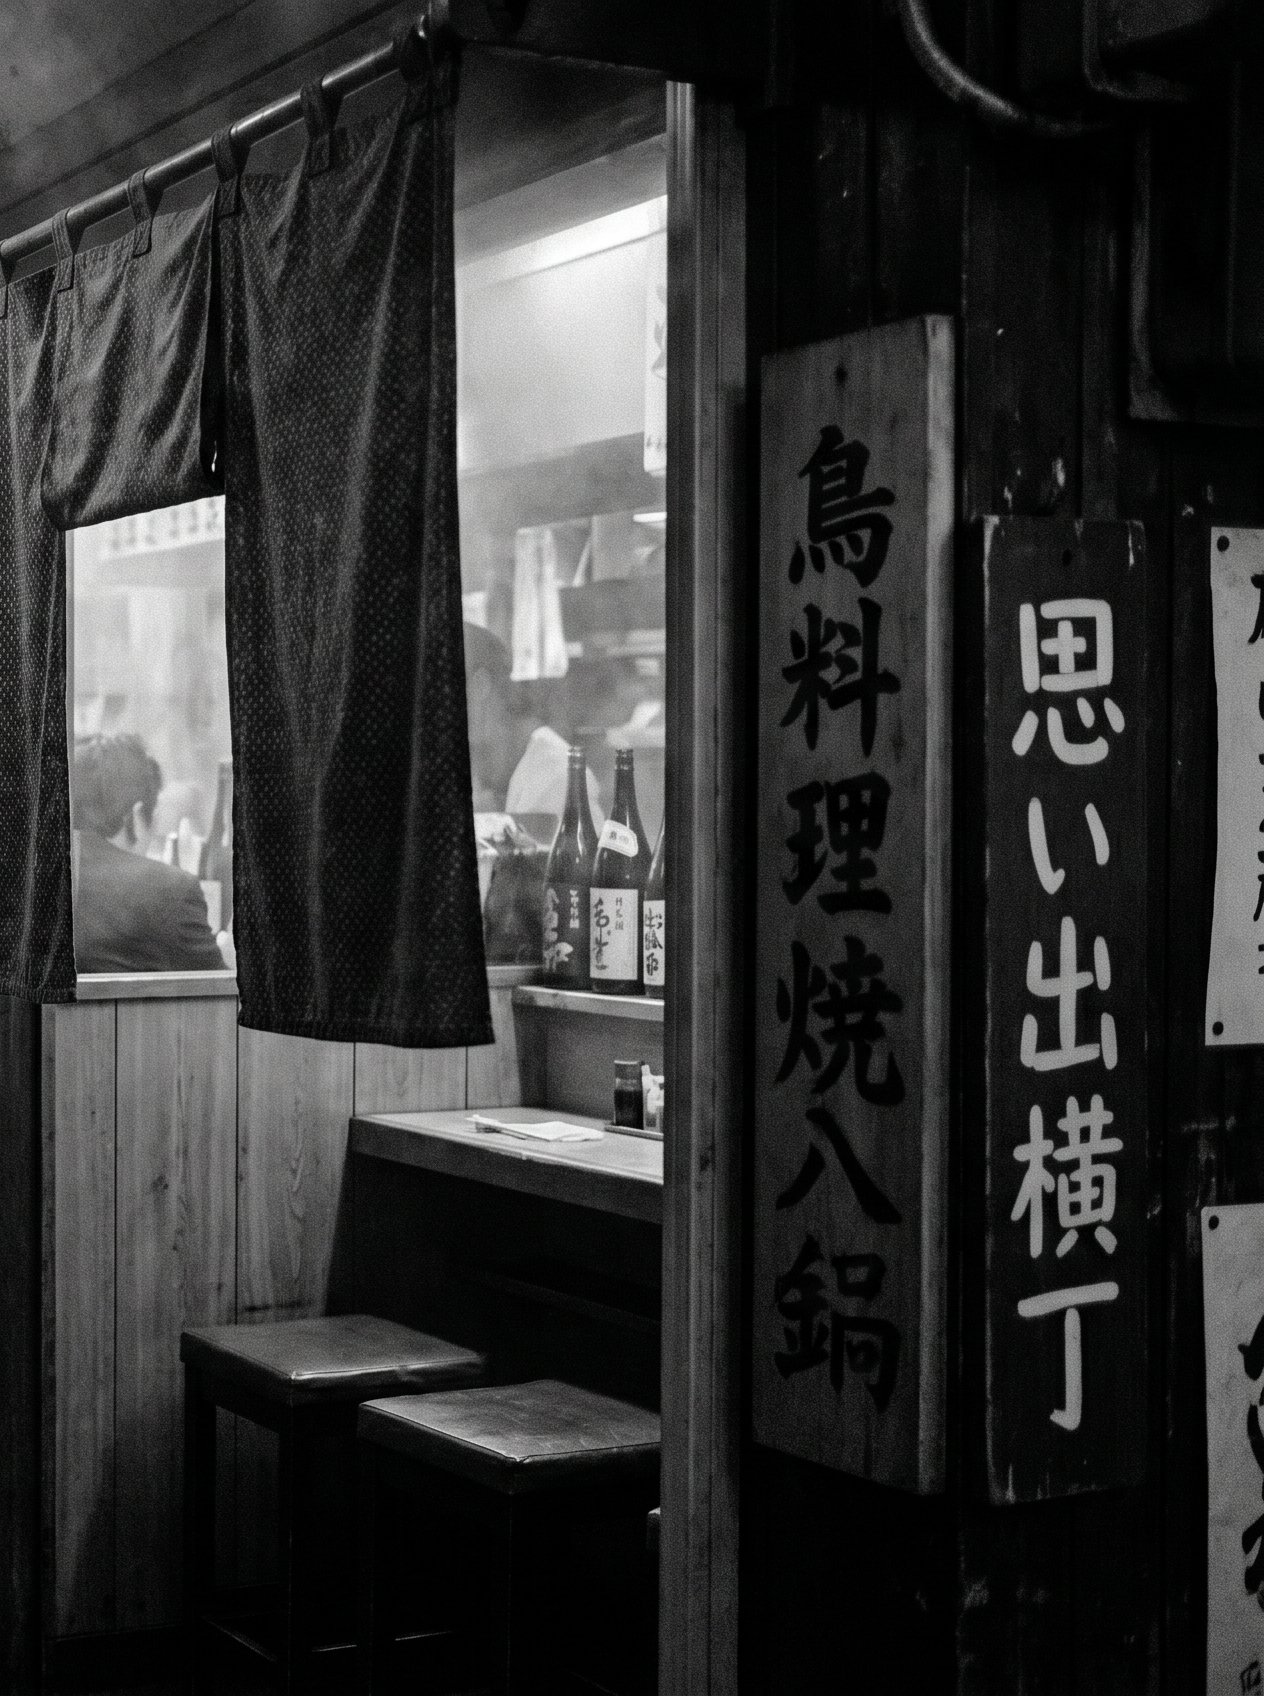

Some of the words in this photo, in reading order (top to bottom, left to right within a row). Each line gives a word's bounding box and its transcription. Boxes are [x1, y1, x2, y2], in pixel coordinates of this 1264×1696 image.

[1011, 598, 1125, 1430] 思い出横丁
